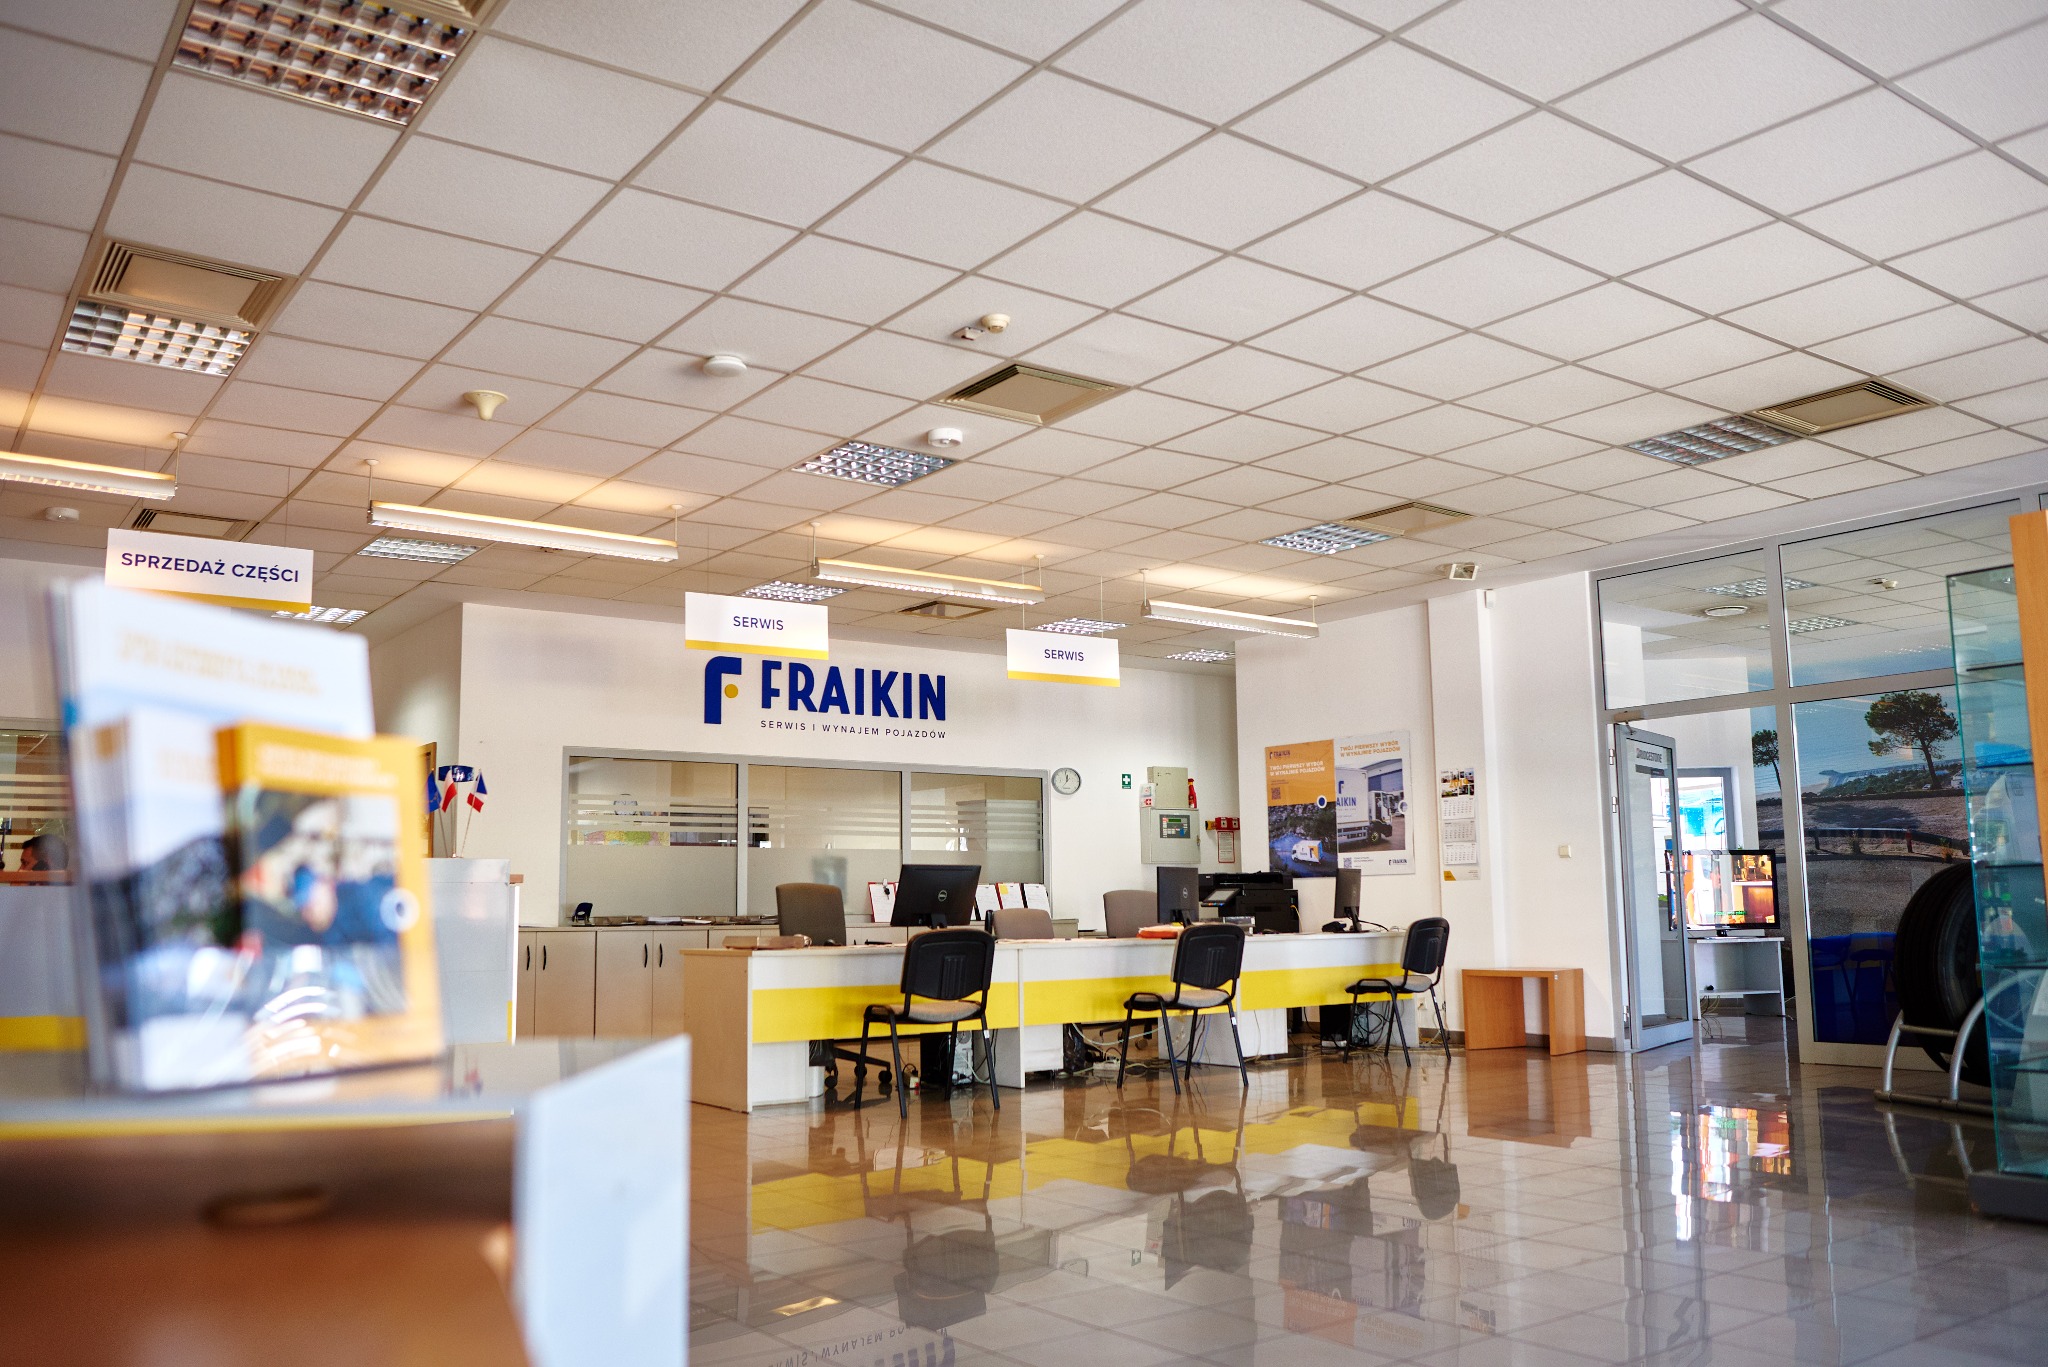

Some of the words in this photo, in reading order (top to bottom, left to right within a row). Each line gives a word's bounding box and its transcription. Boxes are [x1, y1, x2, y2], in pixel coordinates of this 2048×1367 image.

[121, 552, 226, 576] SPRZEDAŻ
[231, 564, 299, 583] CZĘŚCI
[733, 615, 785, 631] SERWIS
[1044, 648, 1085, 662] SERWIS
[761, 659, 947, 721] FRAIKIN
[760, 720, 807, 731] SERWIS
[812, 723, 816, 732] I
[822, 724, 880, 736] WYNAJEM
[885, 728, 947, 740] POJAZDÓW
